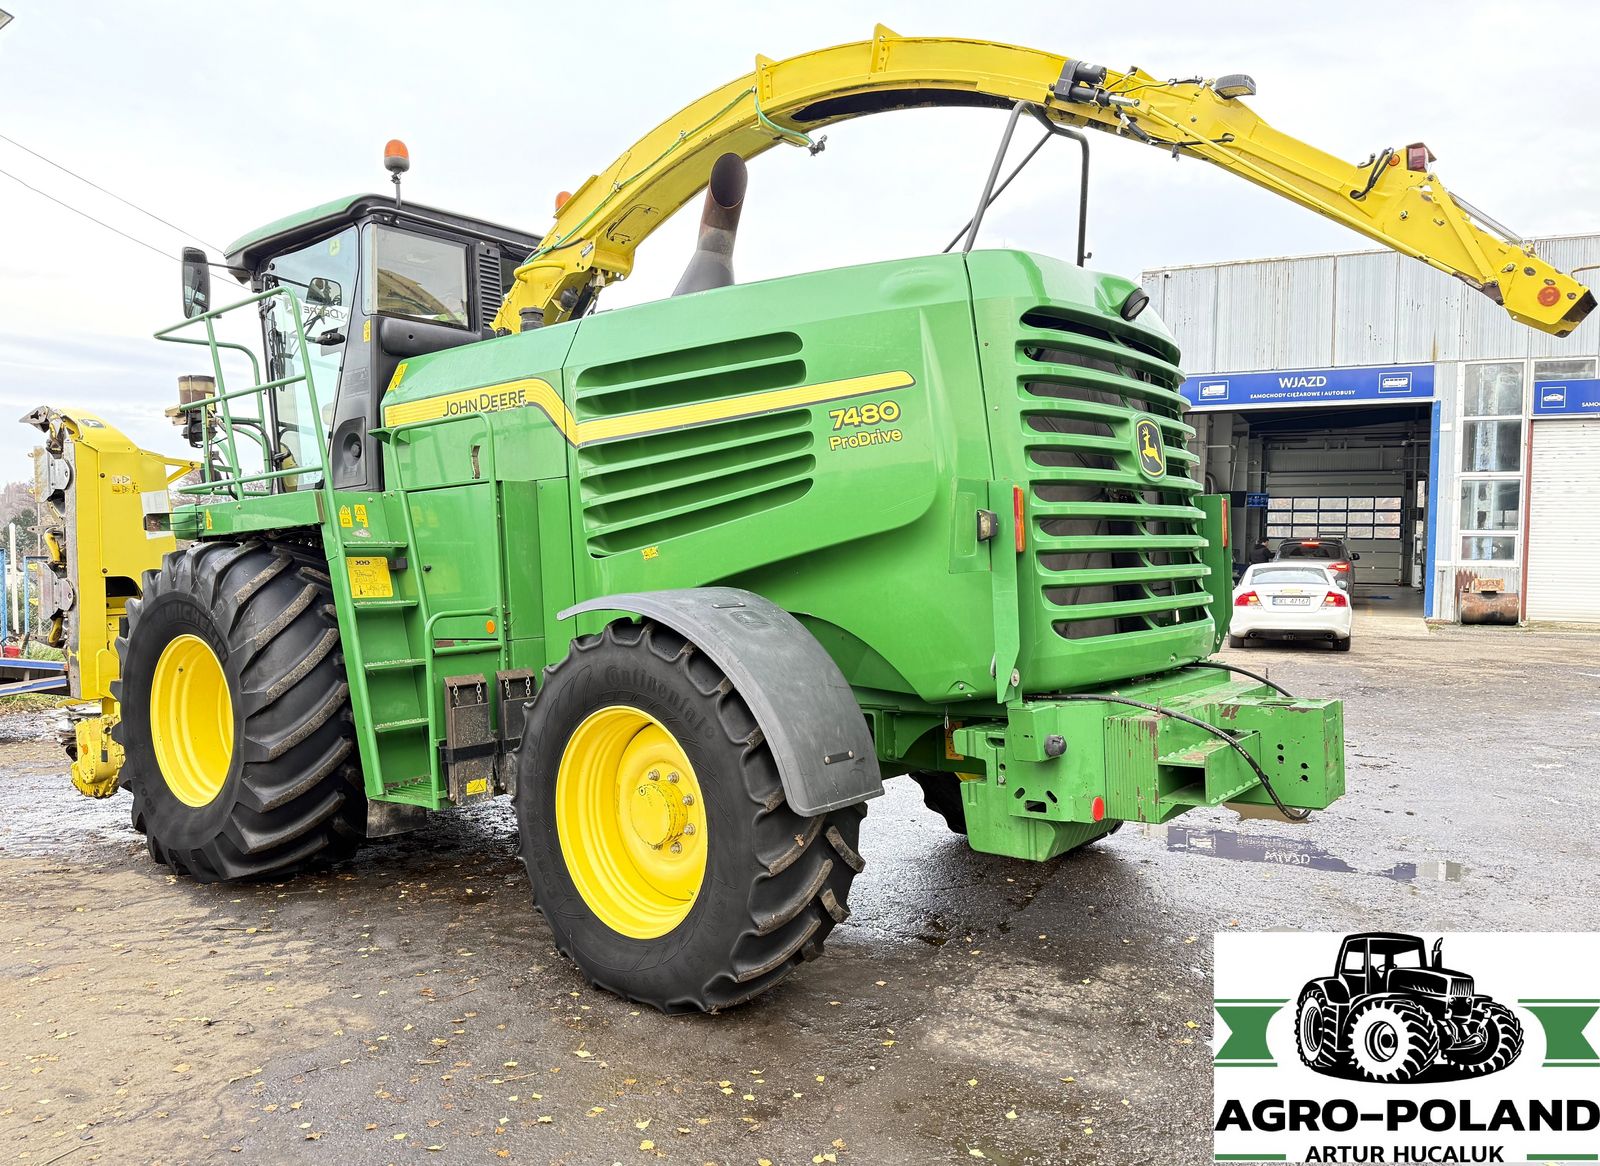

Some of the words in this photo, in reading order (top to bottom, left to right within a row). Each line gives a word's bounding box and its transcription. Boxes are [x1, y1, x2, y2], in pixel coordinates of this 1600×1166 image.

[1279, 376, 1327, 388] WJAZD
[443, 399, 477, 417] JOHN
[480, 389, 526, 410] DEERE
[829, 400, 901, 431] 7480
[829, 429, 902, 451] ProDrive
